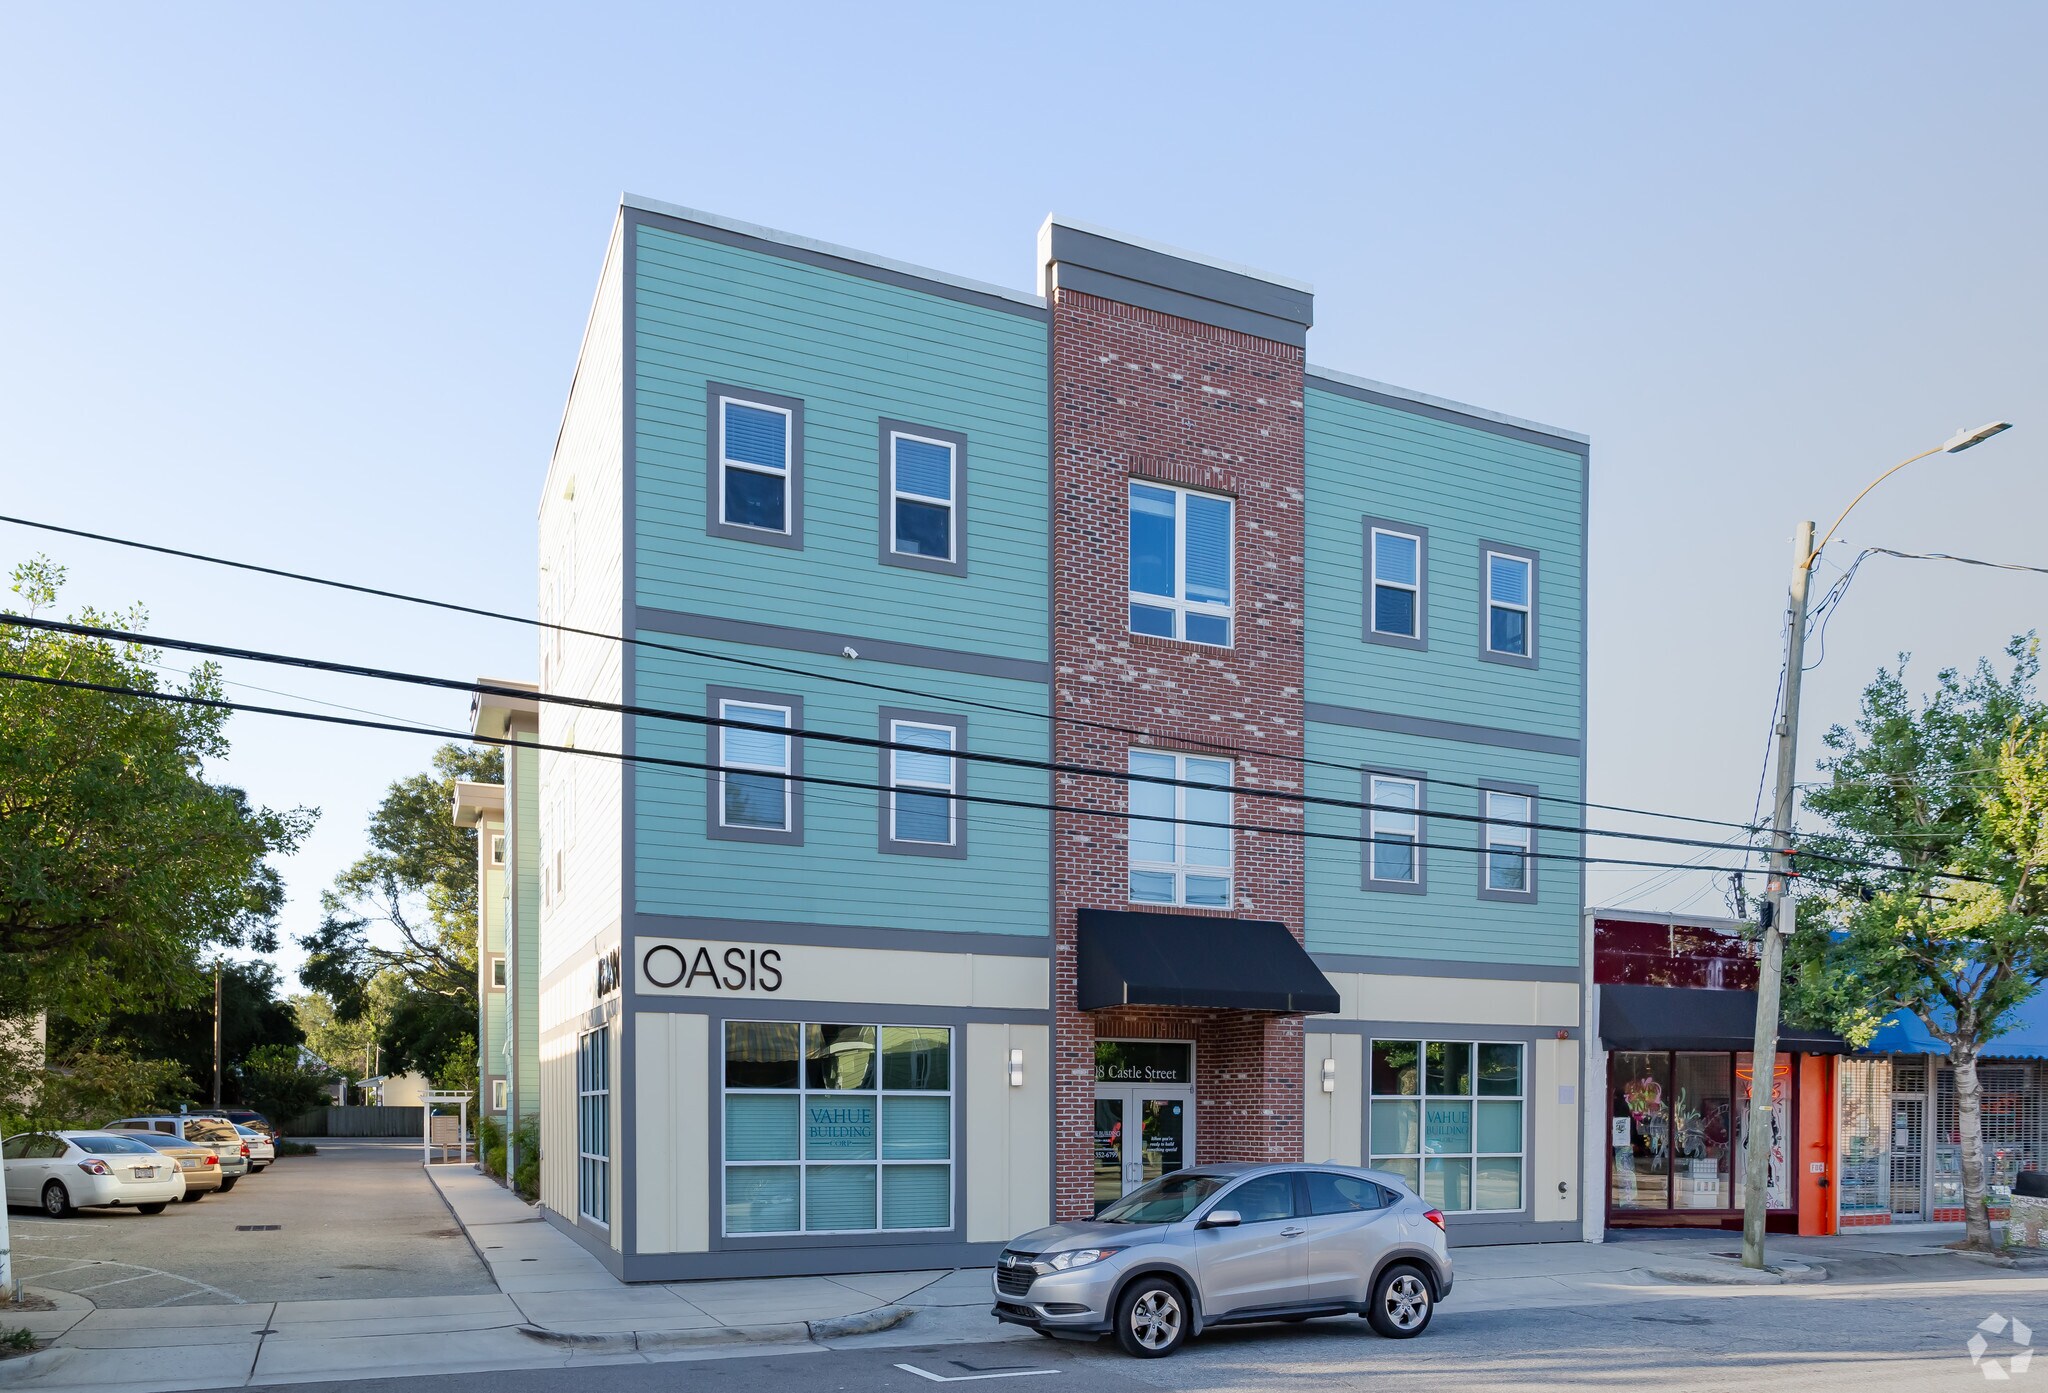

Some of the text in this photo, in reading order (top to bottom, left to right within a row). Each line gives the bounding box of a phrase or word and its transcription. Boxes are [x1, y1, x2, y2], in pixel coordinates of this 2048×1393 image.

[643, 944, 783, 992] OASIS
[1108, 1065, 1142, 1079] Castle
[1145, 1065, 1176, 1079] Street
[809, 1108, 871, 1124] VAHUE
[1427, 1111, 1469, 1123] VAHUE
[809, 1126, 871, 1138] BUILDING
[1426, 1126, 1468, 1136] BUILDING
